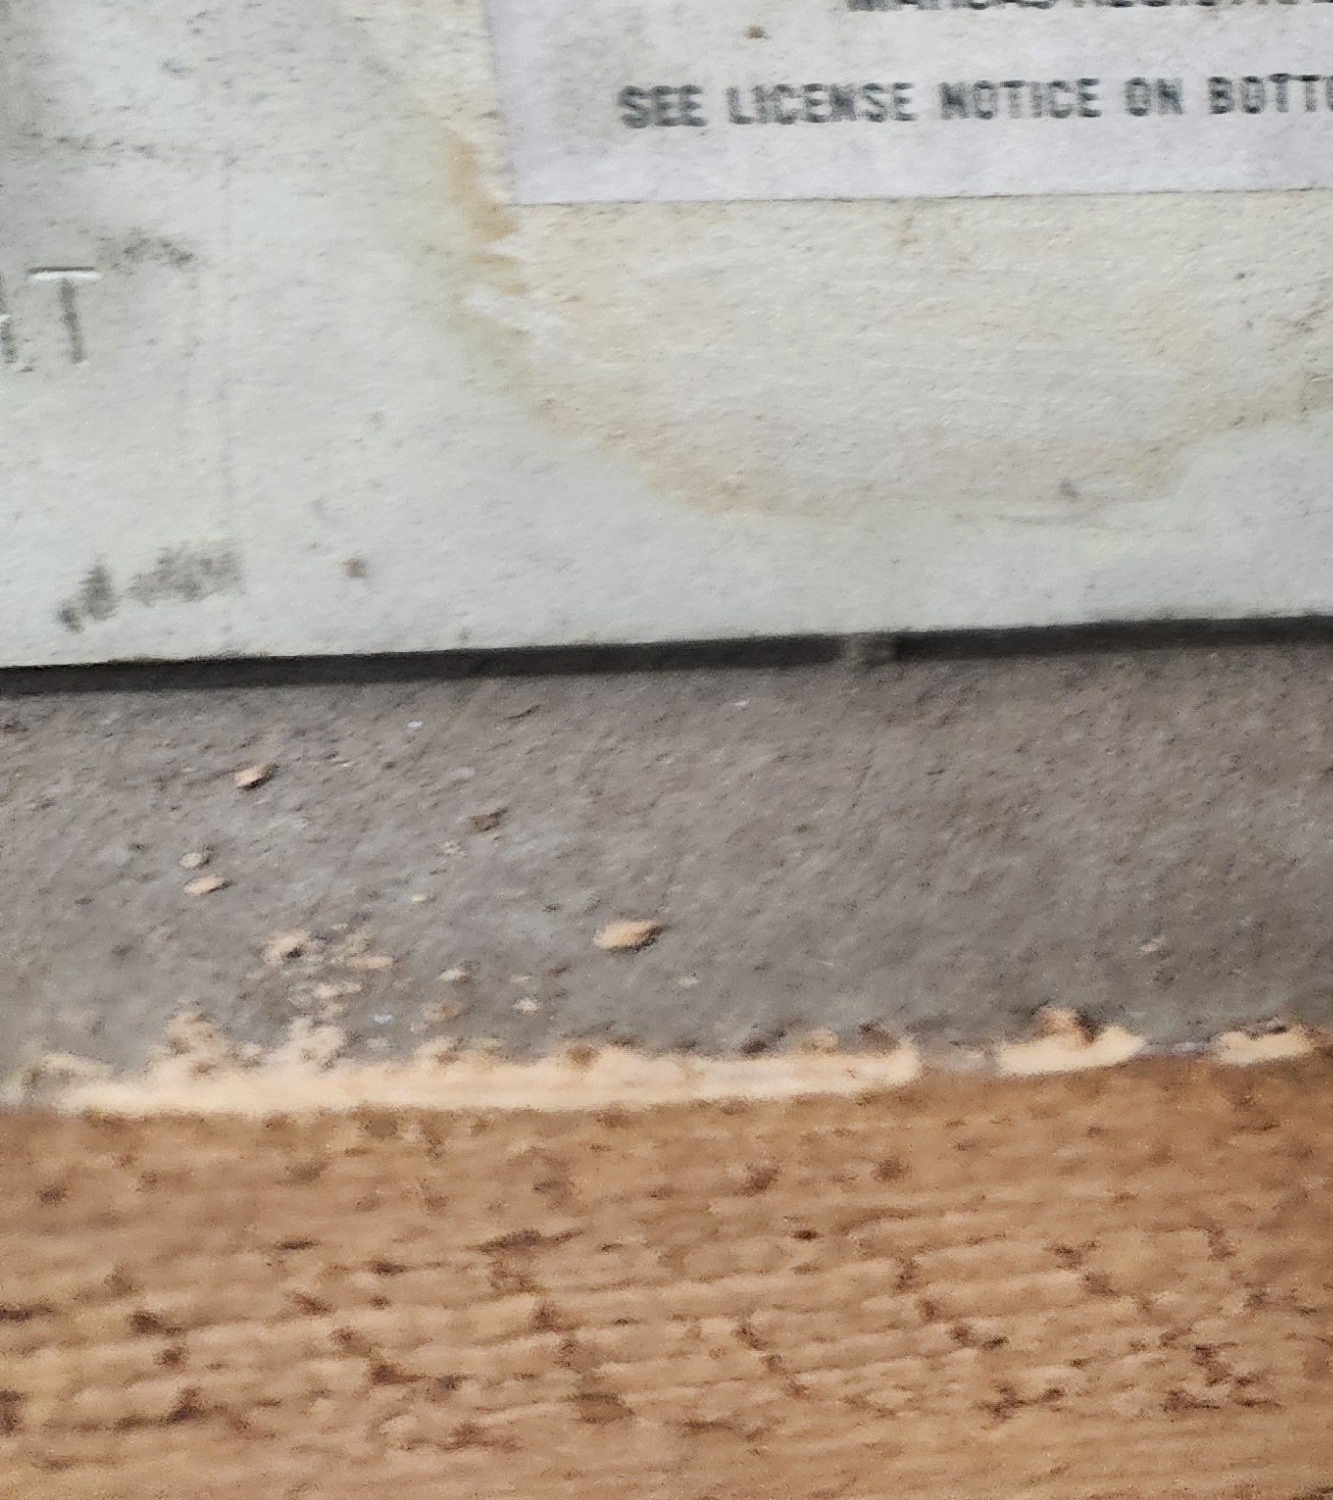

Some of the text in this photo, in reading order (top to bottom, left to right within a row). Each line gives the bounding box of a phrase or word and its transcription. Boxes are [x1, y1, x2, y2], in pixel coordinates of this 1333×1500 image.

[617, 84, 708, 128] SEE
[725, 81, 918, 125] LICENSE
[937, 77, 1102, 121] NOTICE
[1124, 76, 1185, 118] ON
